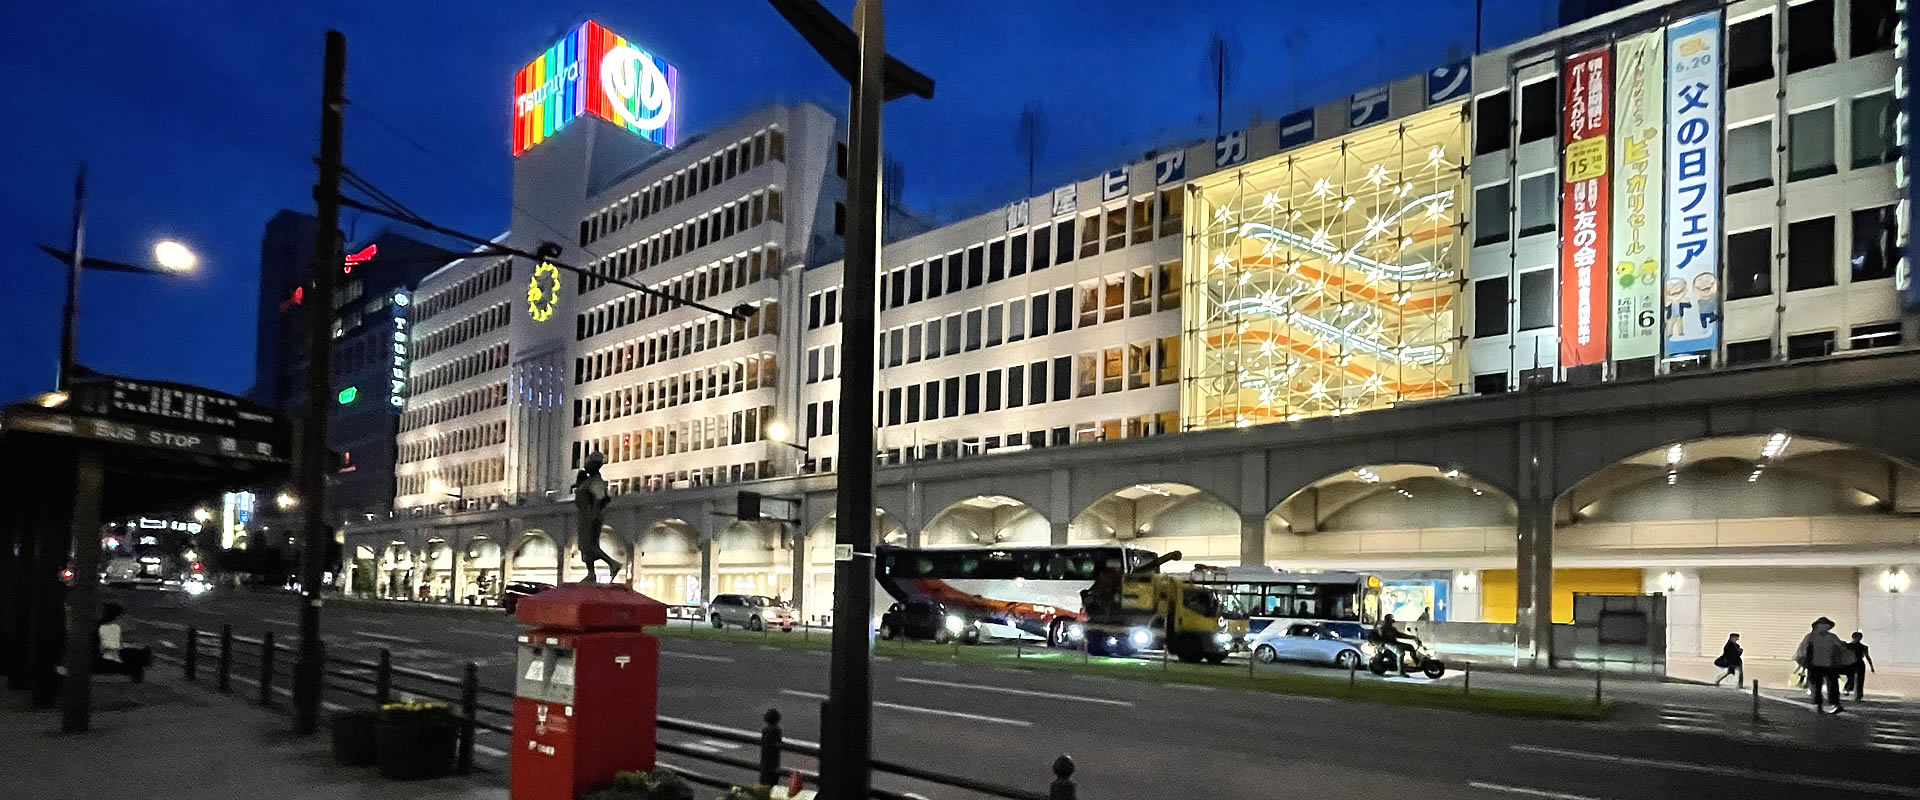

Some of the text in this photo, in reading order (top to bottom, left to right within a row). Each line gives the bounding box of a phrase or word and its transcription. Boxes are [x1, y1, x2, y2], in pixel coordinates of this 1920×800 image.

[518, 60, 579, 117] Tsuruya
[1676, 54, 1711, 72] 6.20
[1677, 82, 1710, 269] 父の日フェア
[391, 317, 407, 407] Tsuruya
[94, 419, 138, 441] BUS
[150, 431, 201, 447] STOP
